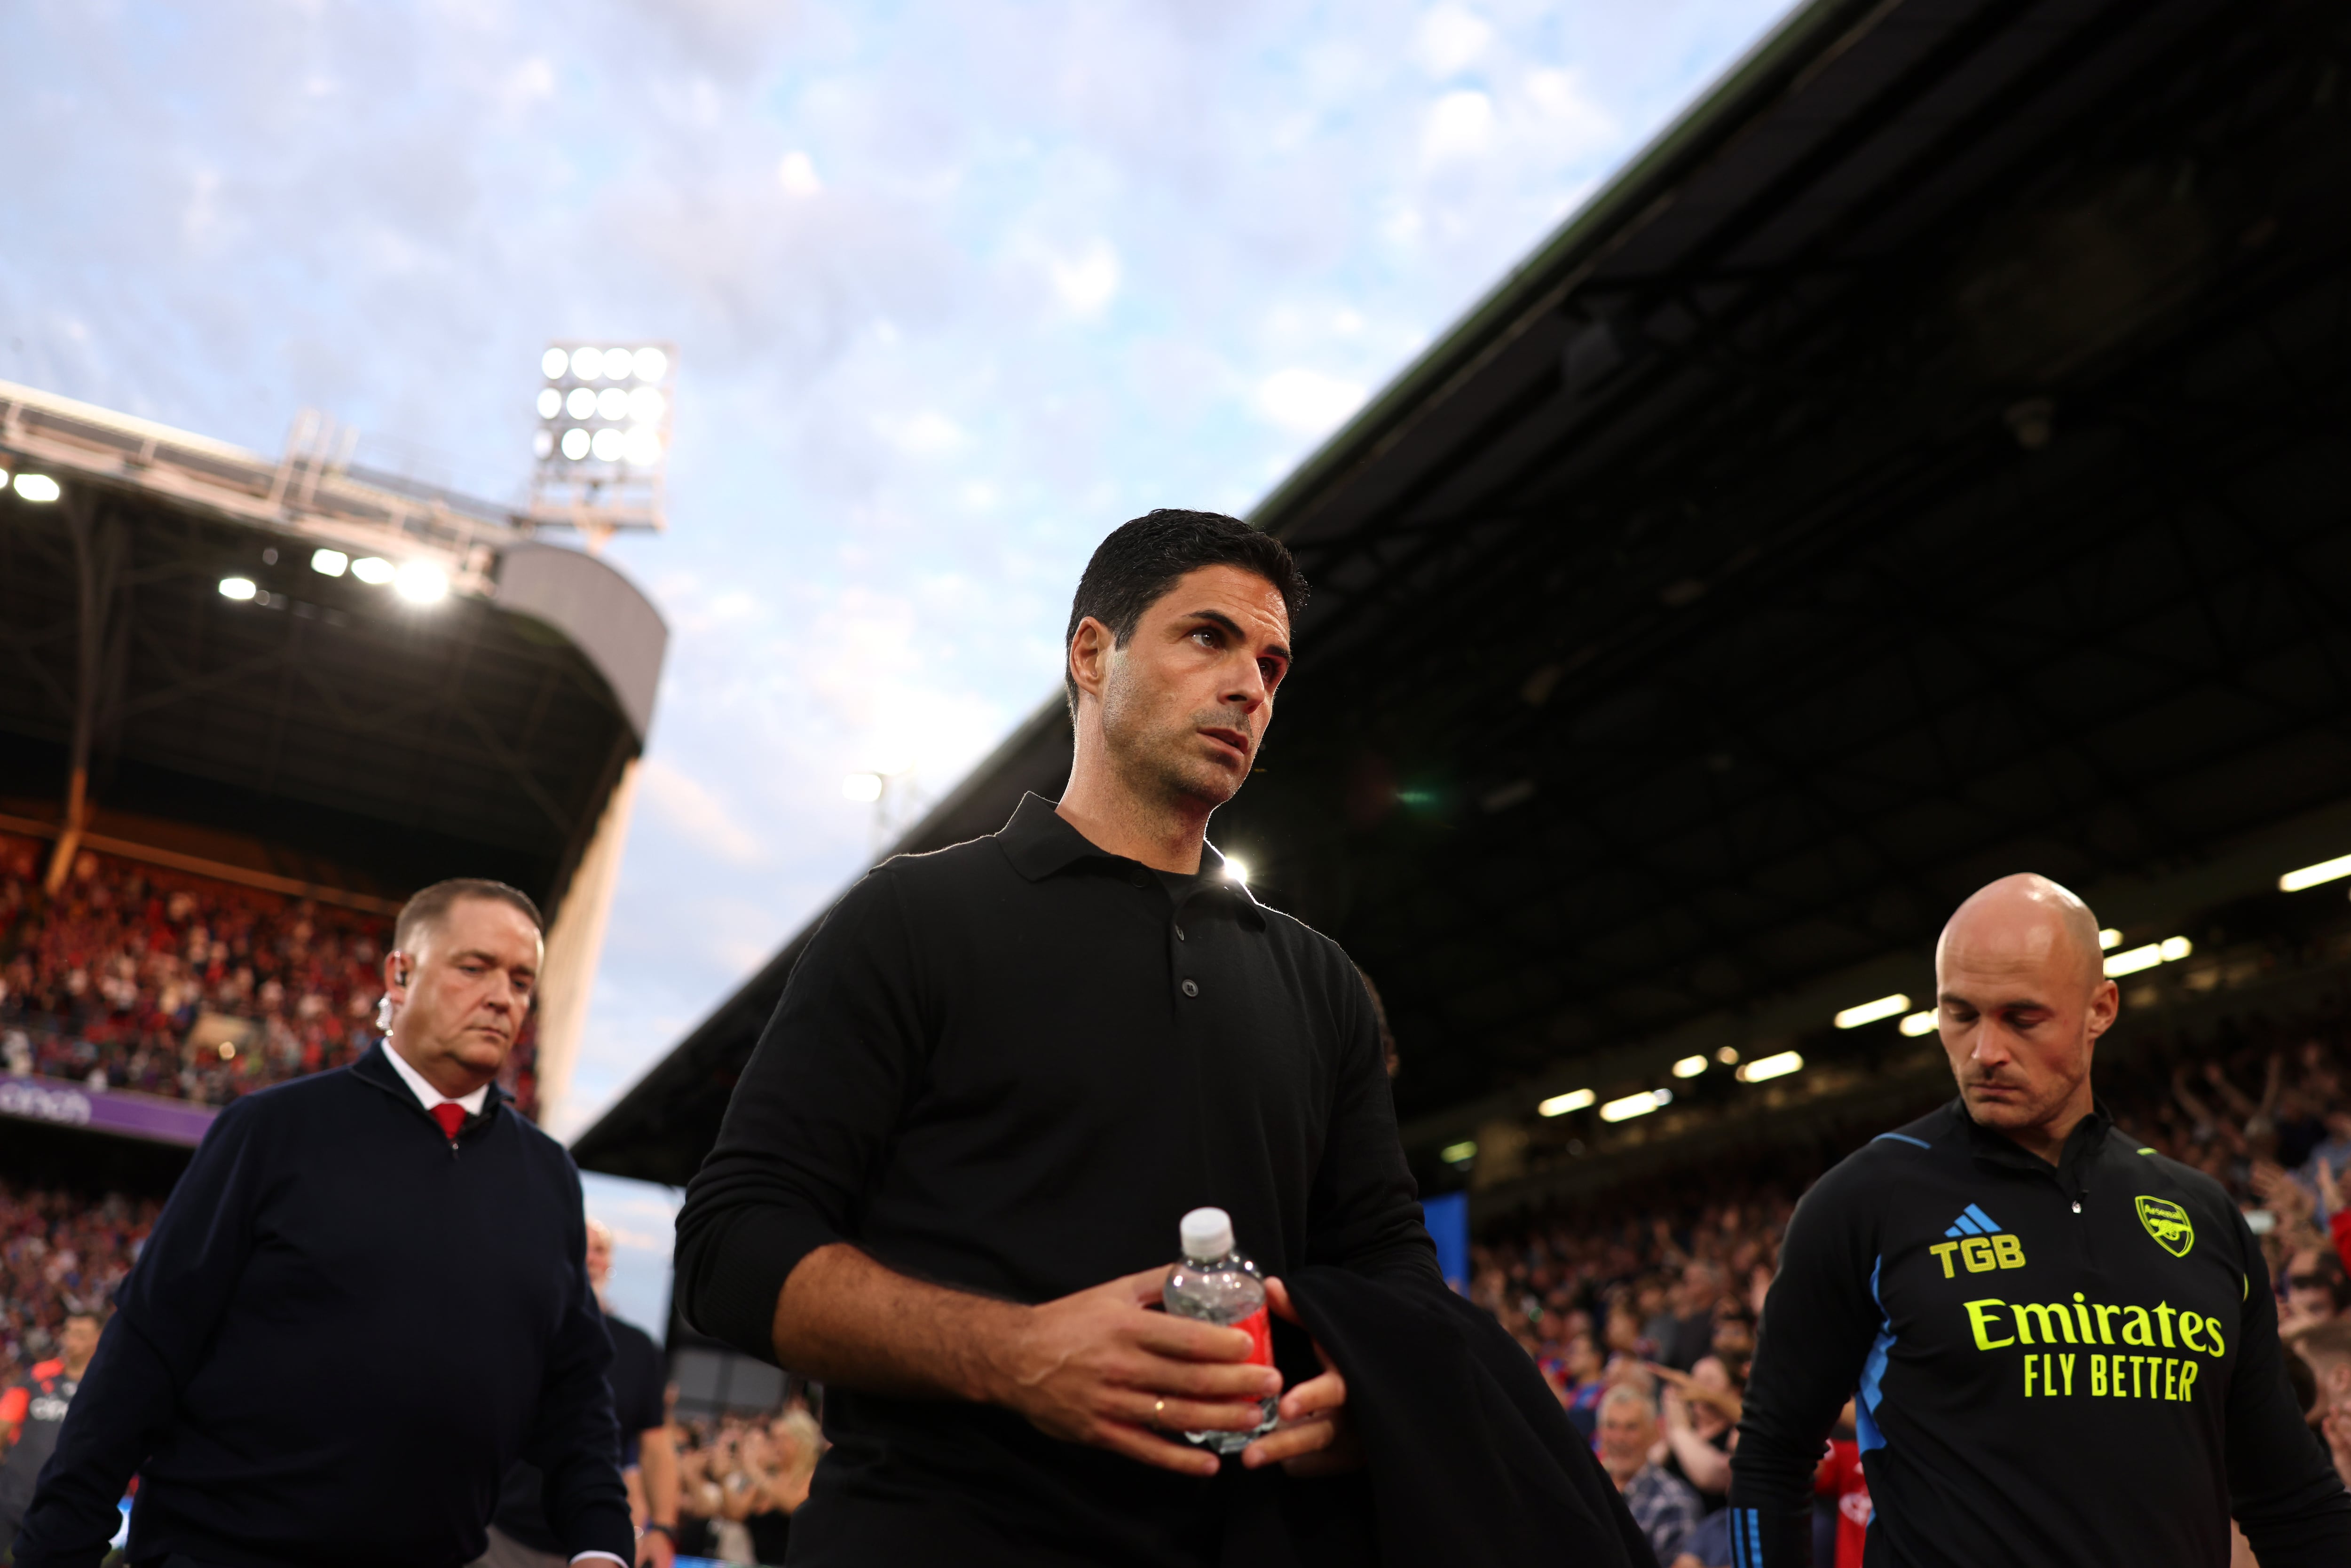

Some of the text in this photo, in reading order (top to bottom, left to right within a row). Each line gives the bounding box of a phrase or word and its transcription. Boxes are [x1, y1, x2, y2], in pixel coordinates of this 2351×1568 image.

[2144, 1204, 2183, 1220] Arsenal
[1929, 1234, 2027, 1279] TGB
[1962, 1291, 2225, 1358] Emirates
[2024, 1353, 2199, 1403] FLY BETTER
